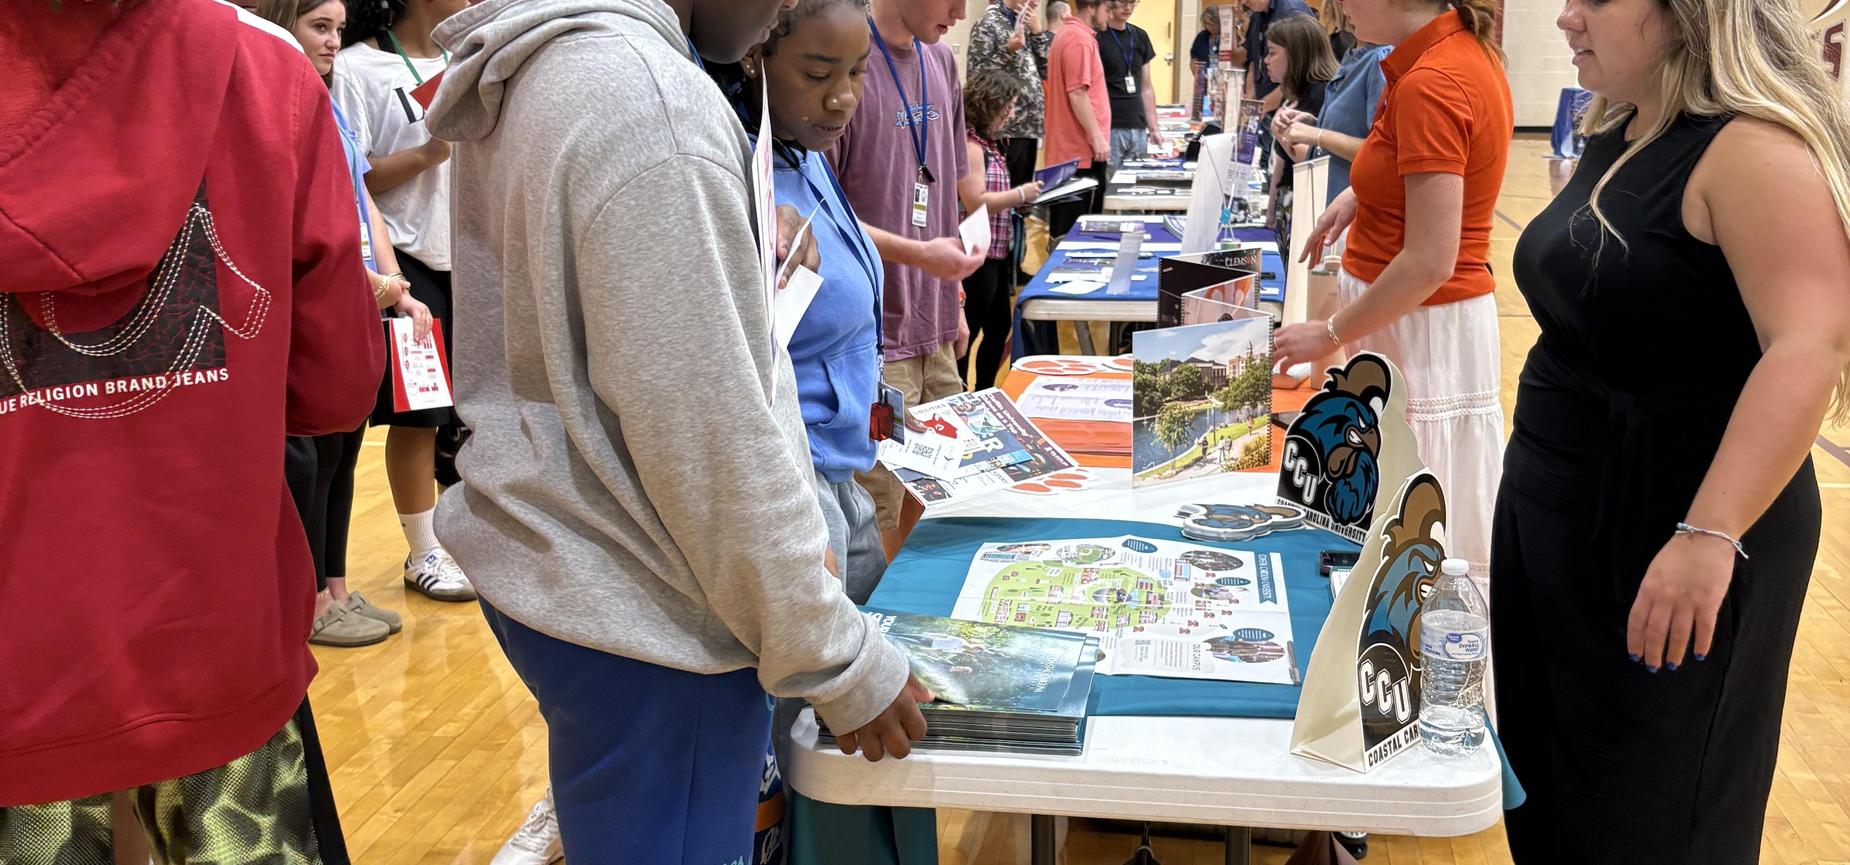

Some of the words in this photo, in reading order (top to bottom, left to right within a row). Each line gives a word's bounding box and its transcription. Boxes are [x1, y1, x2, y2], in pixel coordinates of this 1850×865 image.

[20, 383, 98, 409] RELIGION
[105, 376, 167, 395] BRAND
[174, 368, 229, 387] JEANS
[1284, 440, 1318, 505] CCU
[1330, 520, 1367, 543] UNIVERSITY
[1360, 659, 1411, 724] CCU
[1368, 735, 1402, 767] COASTAL
